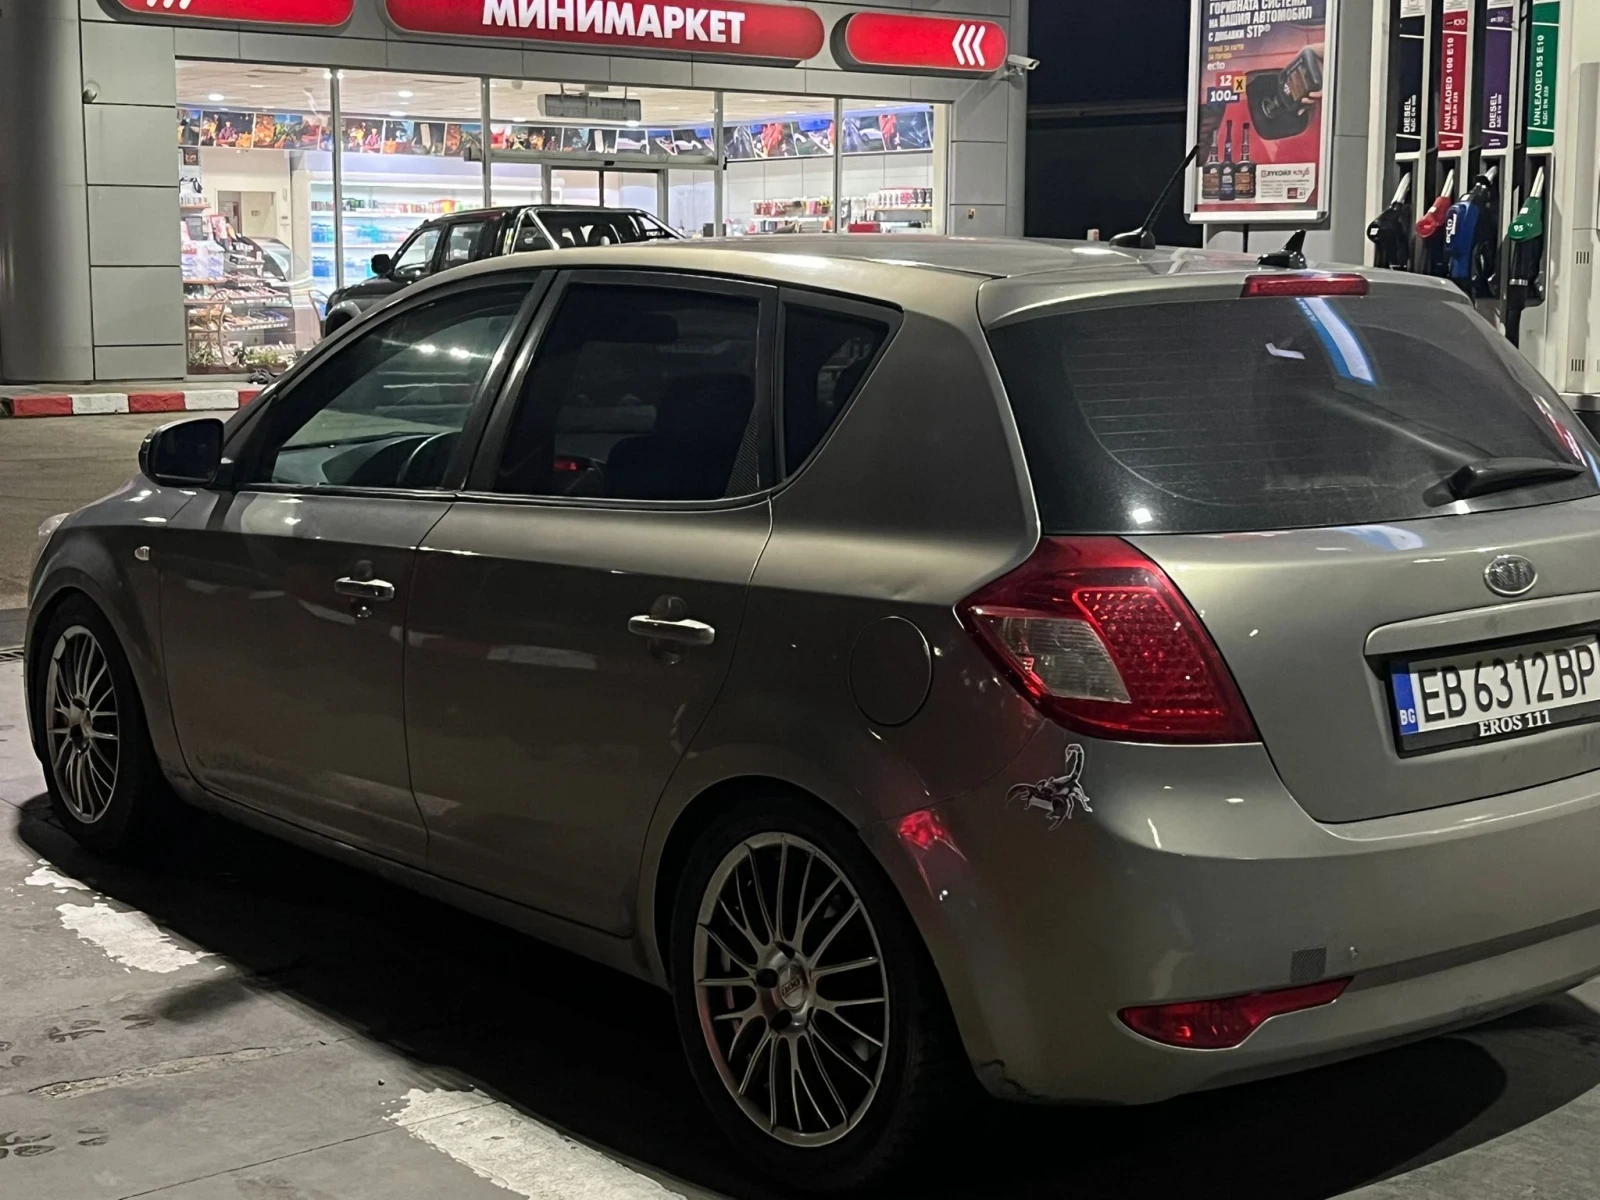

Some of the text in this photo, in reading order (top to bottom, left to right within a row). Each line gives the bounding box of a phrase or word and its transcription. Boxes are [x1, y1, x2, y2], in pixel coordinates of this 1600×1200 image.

[1210, 0, 1259, 15] ГОРИВНАТА
[1253, 6, 1313, 24] АВТОМОБИЛ
[482, 0, 745, 44] МИНИМАРКЕТ
[1446, 37, 1454, 55] E10
[1220, 75, 1232, 87] 12
[1533, 35, 1545, 126] UNLEADED 95 E10
[1403, 97, 1412, 133] DIESEL
[1443, 76, 1453, 131] UNLEADED
[1489, 92, 1498, 128] DIESEL
[1513, 224, 1524, 232] 95
[1400, 708, 1416, 726] BG
[1478, 709, 1552, 737] EROS 111
